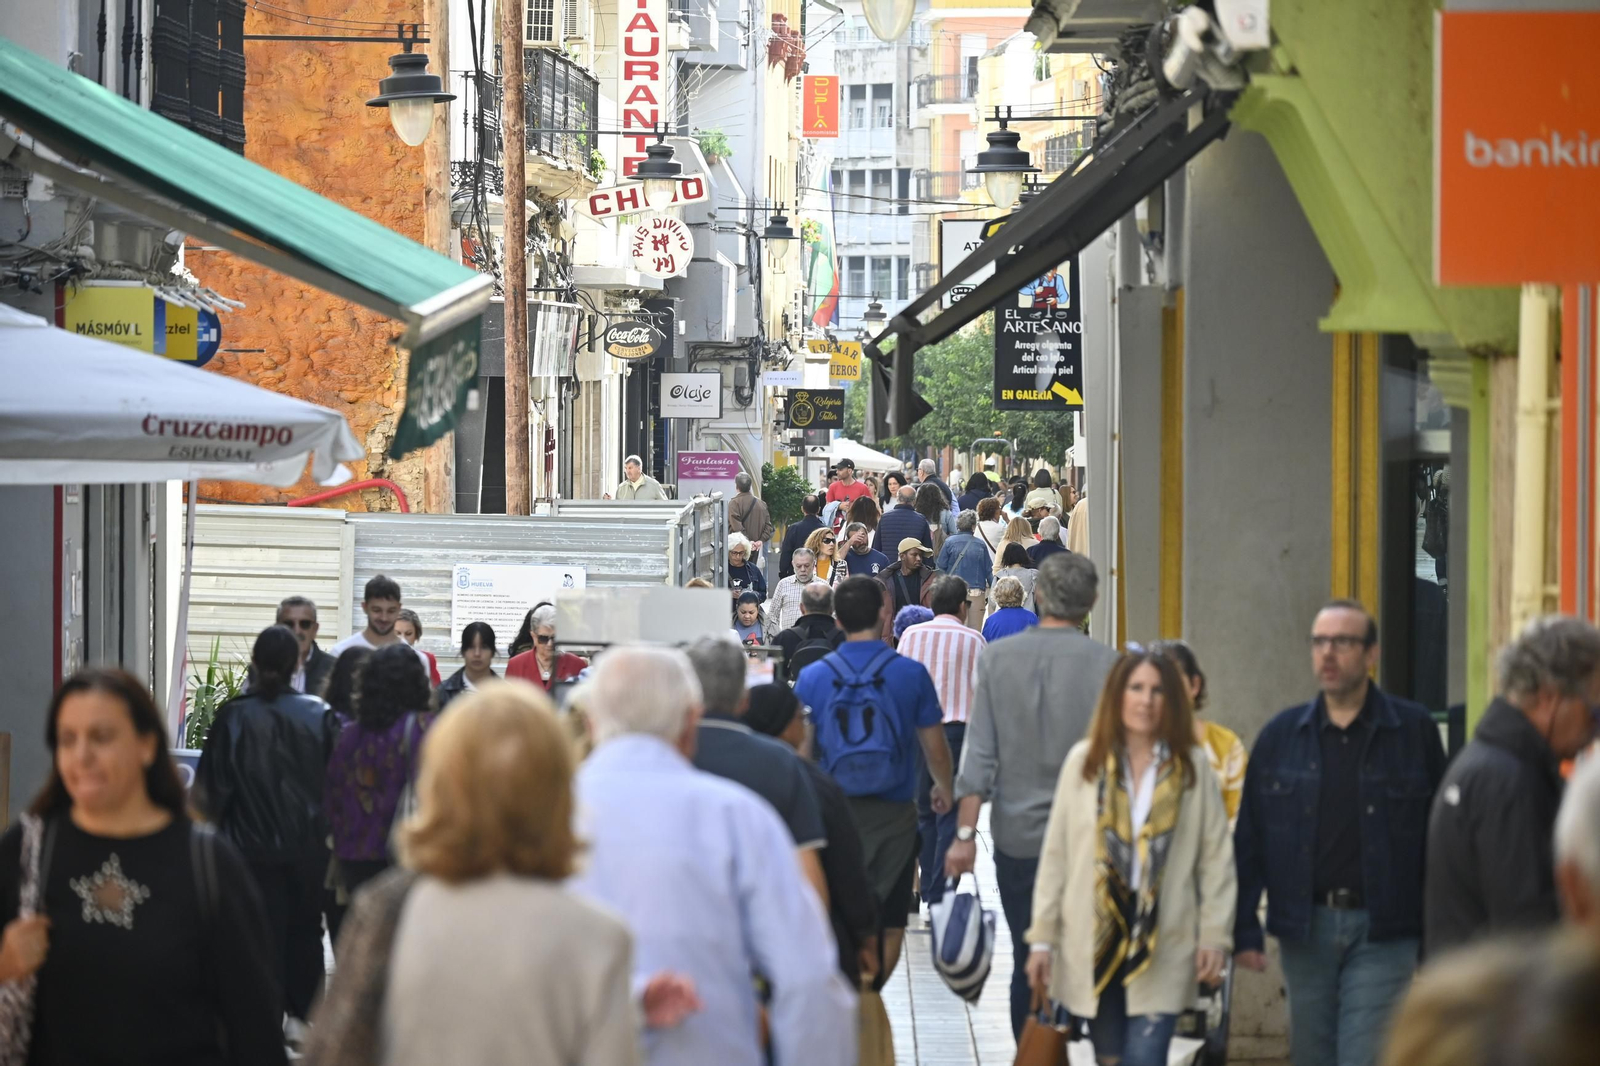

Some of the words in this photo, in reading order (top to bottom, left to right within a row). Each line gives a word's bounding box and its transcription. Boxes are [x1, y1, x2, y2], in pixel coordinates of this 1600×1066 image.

[813, 77, 830, 128] DUPLA
[1005, 309, 1021, 319] EL
[606, 327, 652, 344] Coca-Cola
[1003, 319, 1082, 335] ARTESANO
[1002, 390, 1014, 400] EN
[141, 413, 294, 448] Cruzcampo
[168, 444, 255, 462] ESPECIAL
